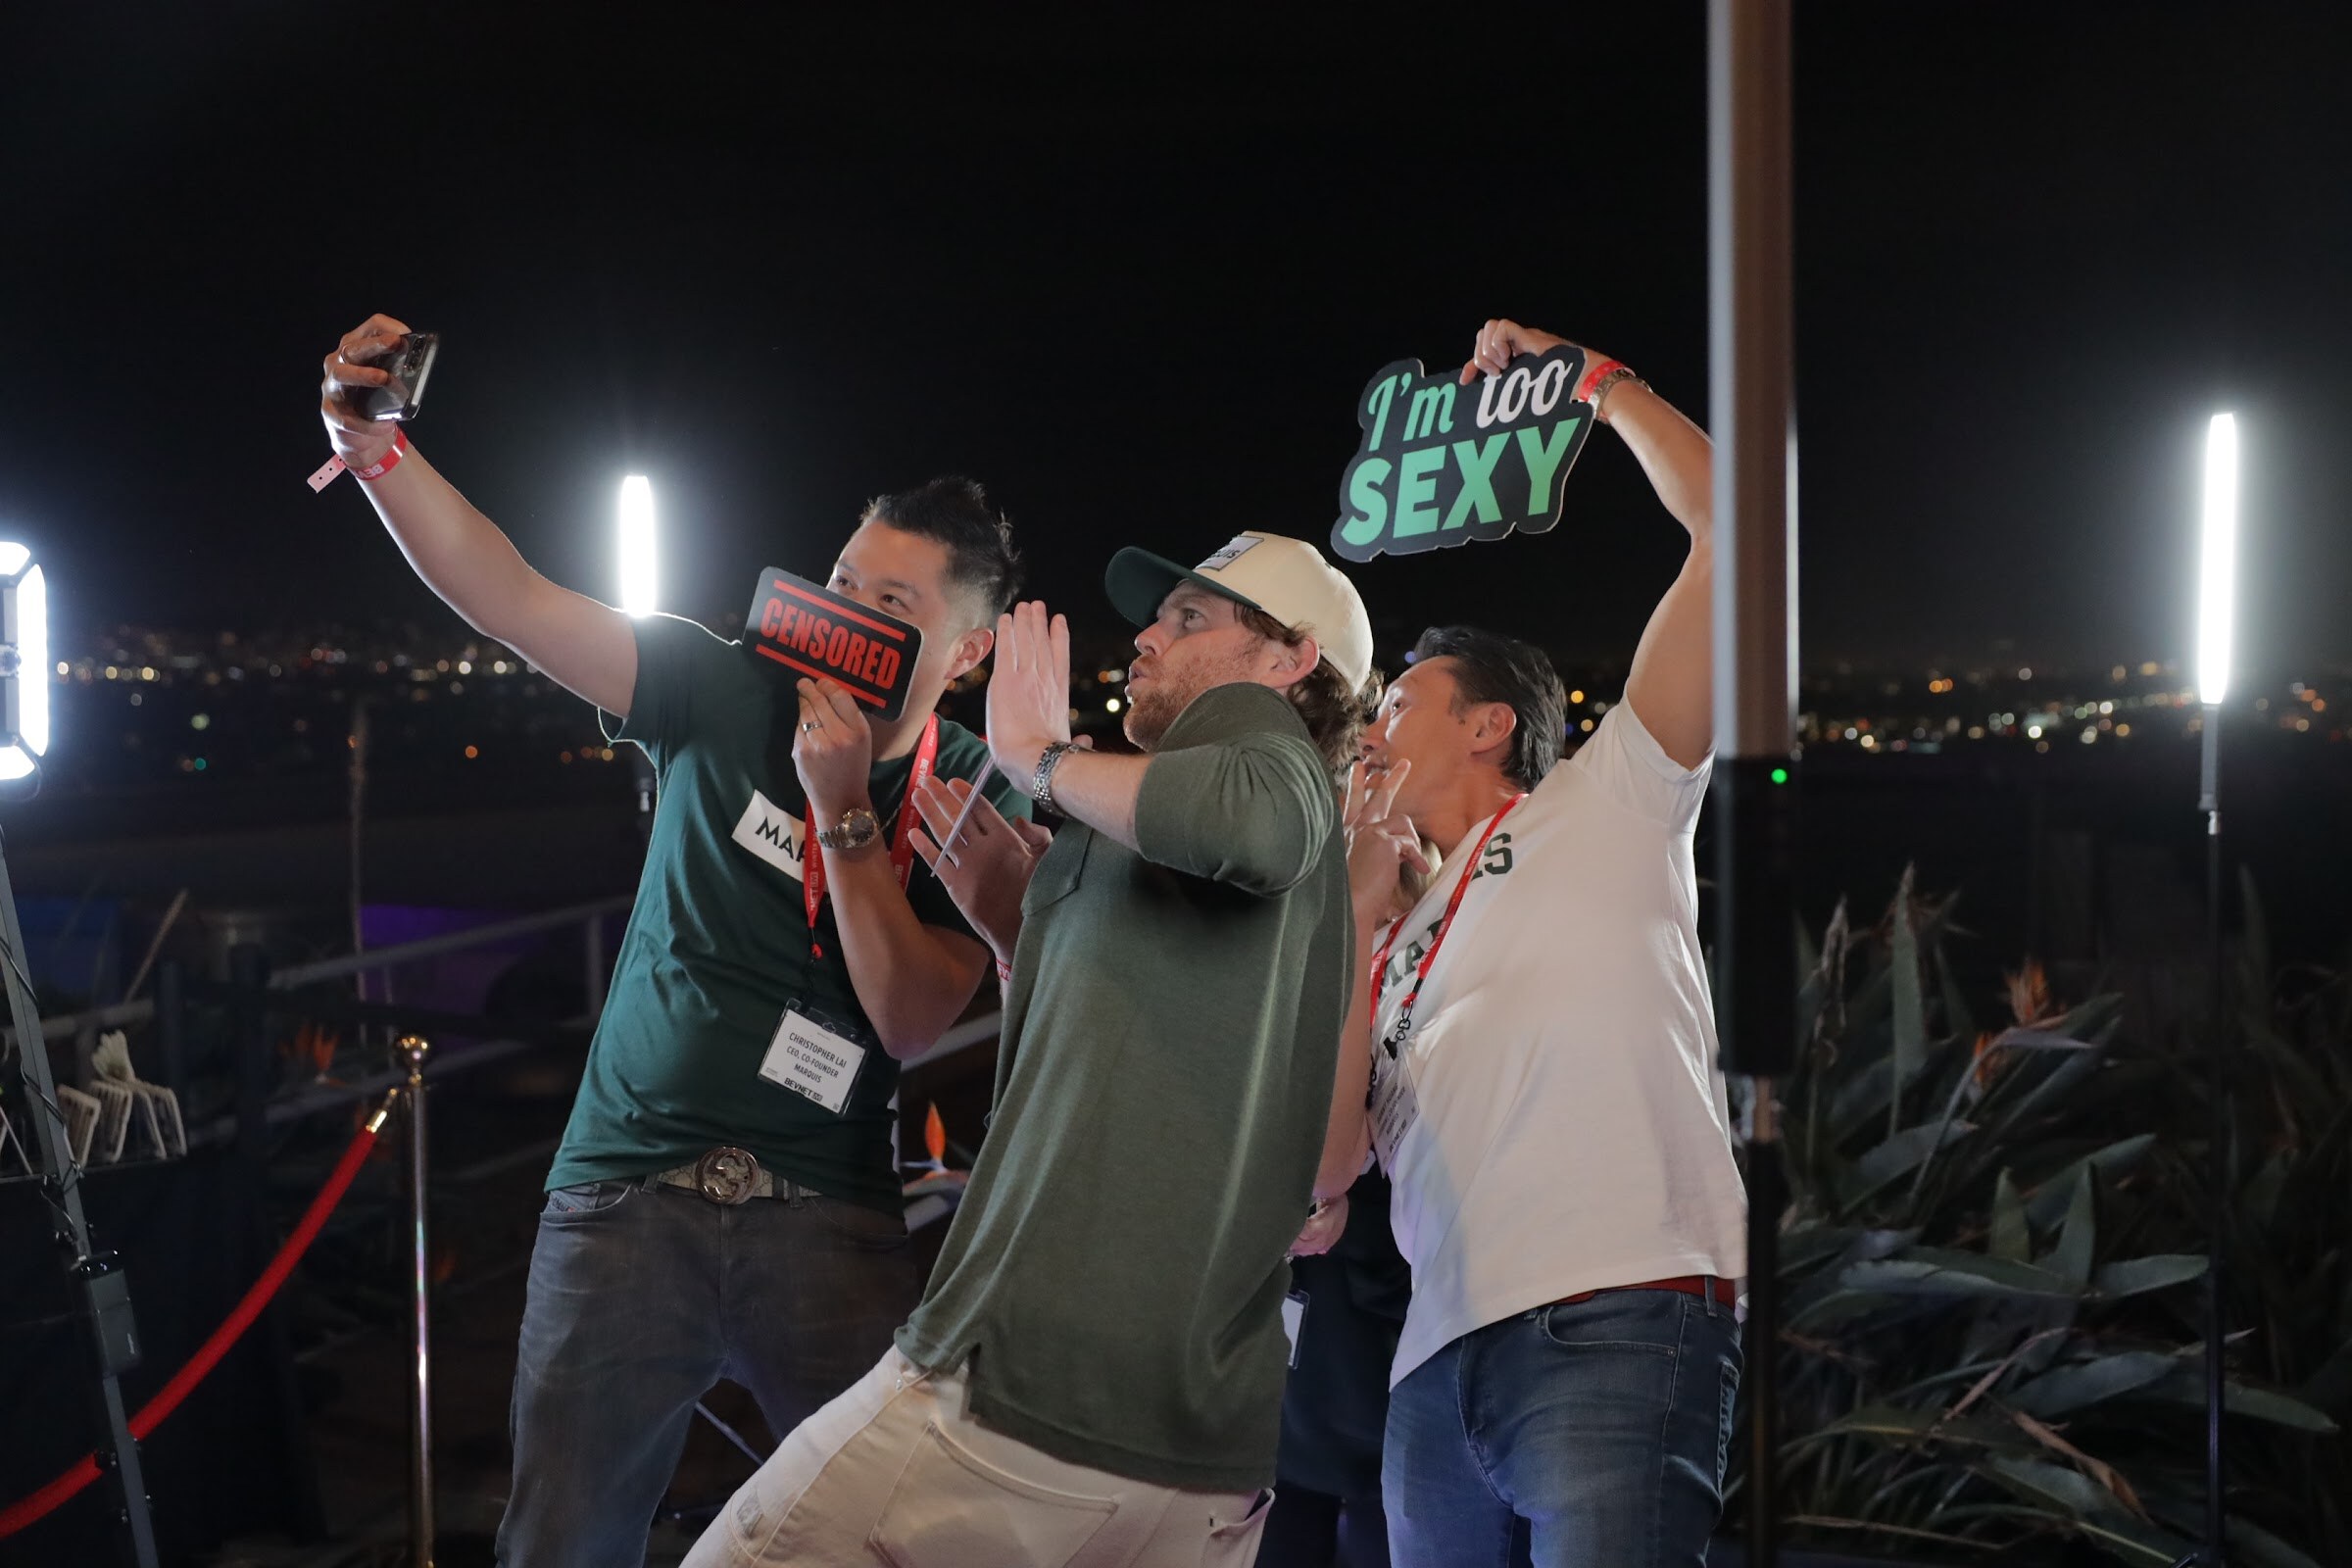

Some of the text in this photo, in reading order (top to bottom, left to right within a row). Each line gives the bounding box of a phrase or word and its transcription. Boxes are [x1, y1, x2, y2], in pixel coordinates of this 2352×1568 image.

[1368, 359, 1574, 452] I'm too
[1341, 417, 1581, 546] SEXY
[760, 597, 901, 690] CENSORED
[786, 1046, 840, 1078] CEO, CO-FOUNDER
[789, 1032, 836, 1063] CHRISTOPHER
[835, 1056, 848, 1068] LAI
[784, 1077, 812, 1097] BEVNET
[794, 1063, 822, 1083] MARQUIS
